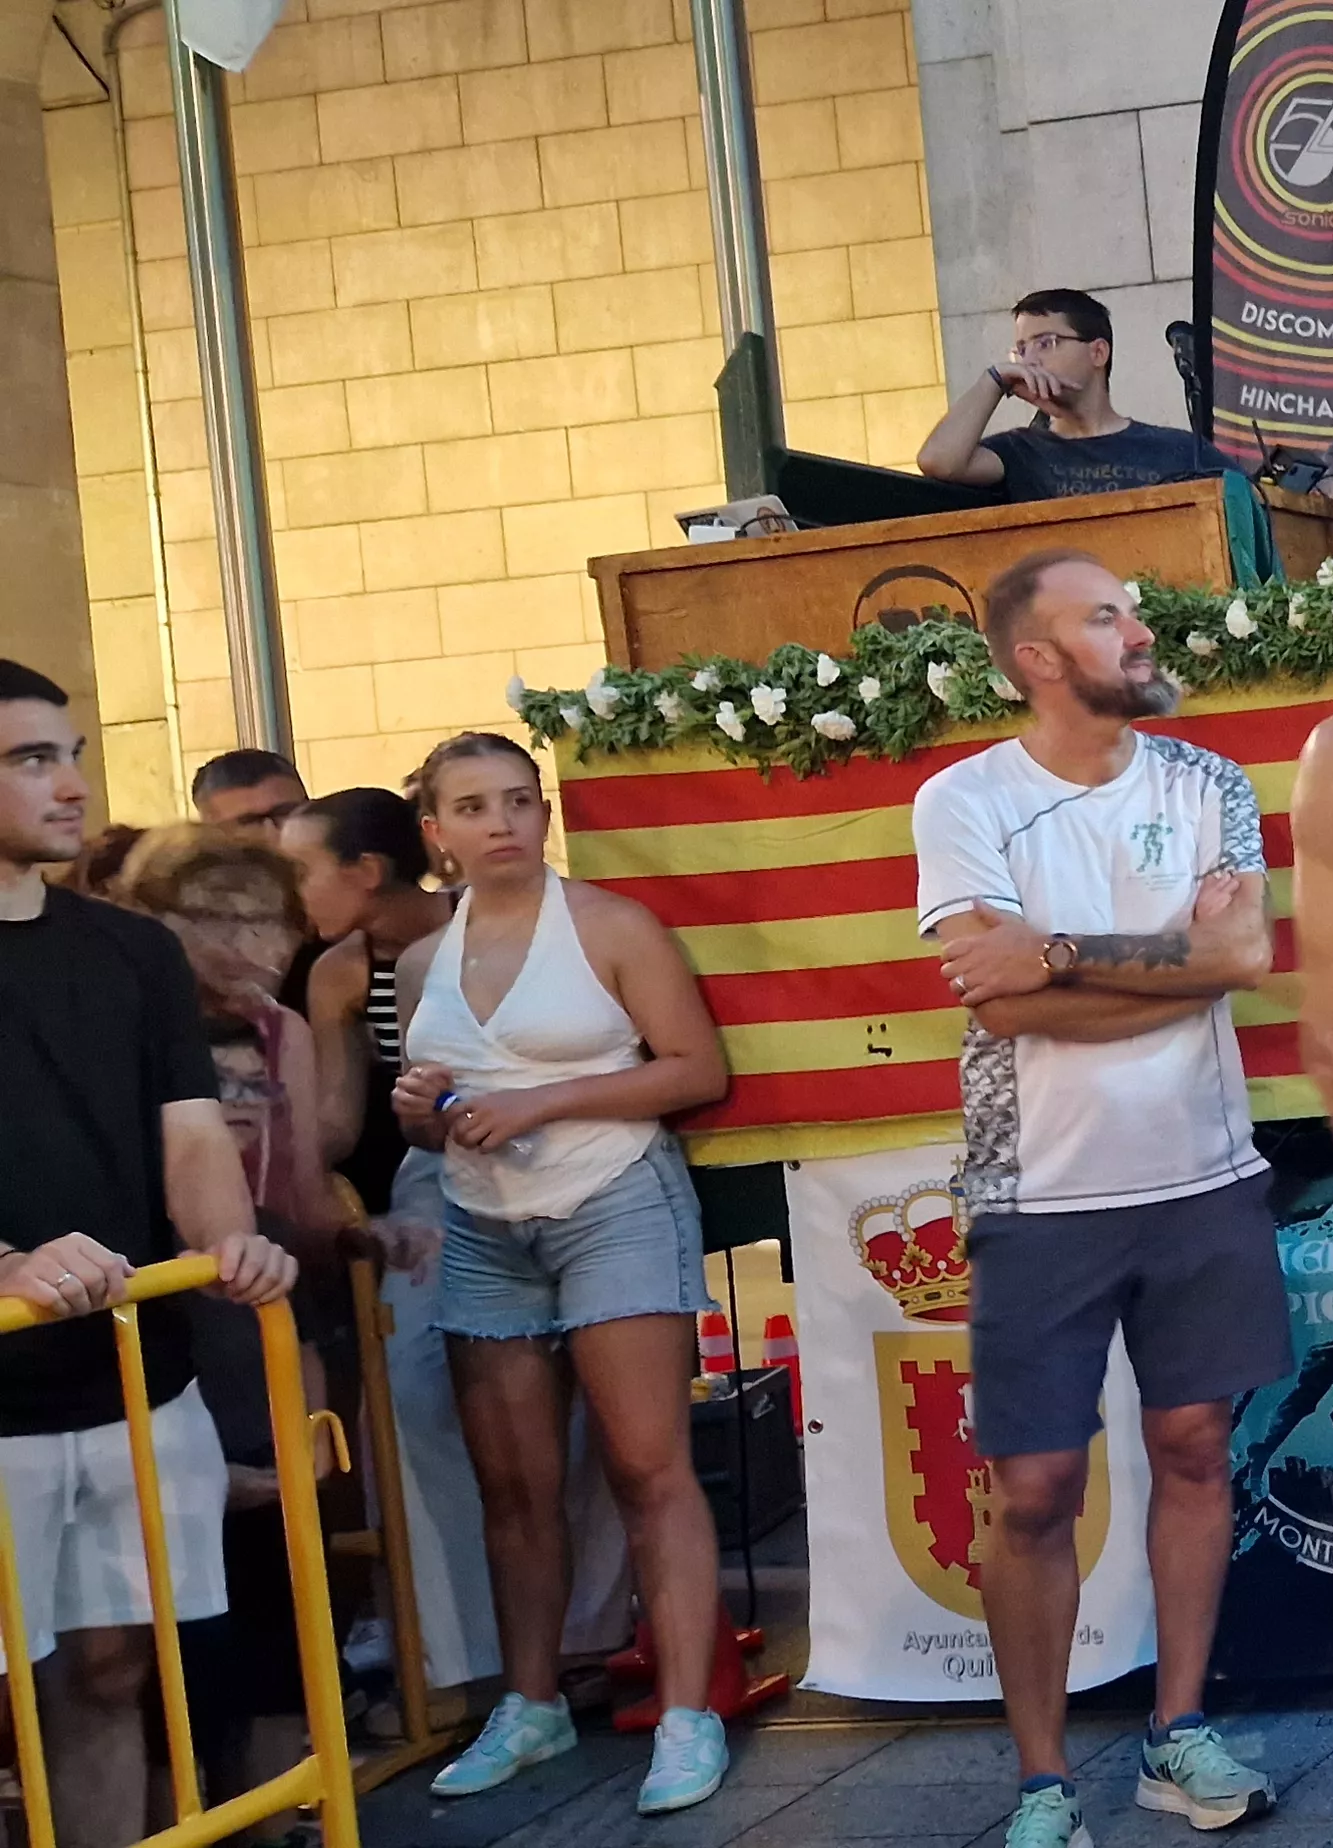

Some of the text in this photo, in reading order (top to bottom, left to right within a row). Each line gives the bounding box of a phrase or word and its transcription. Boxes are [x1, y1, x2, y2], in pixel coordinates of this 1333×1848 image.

[903, 1625, 1105, 1655] Ayunta de
[942, 1653, 995, 1684] Qui
